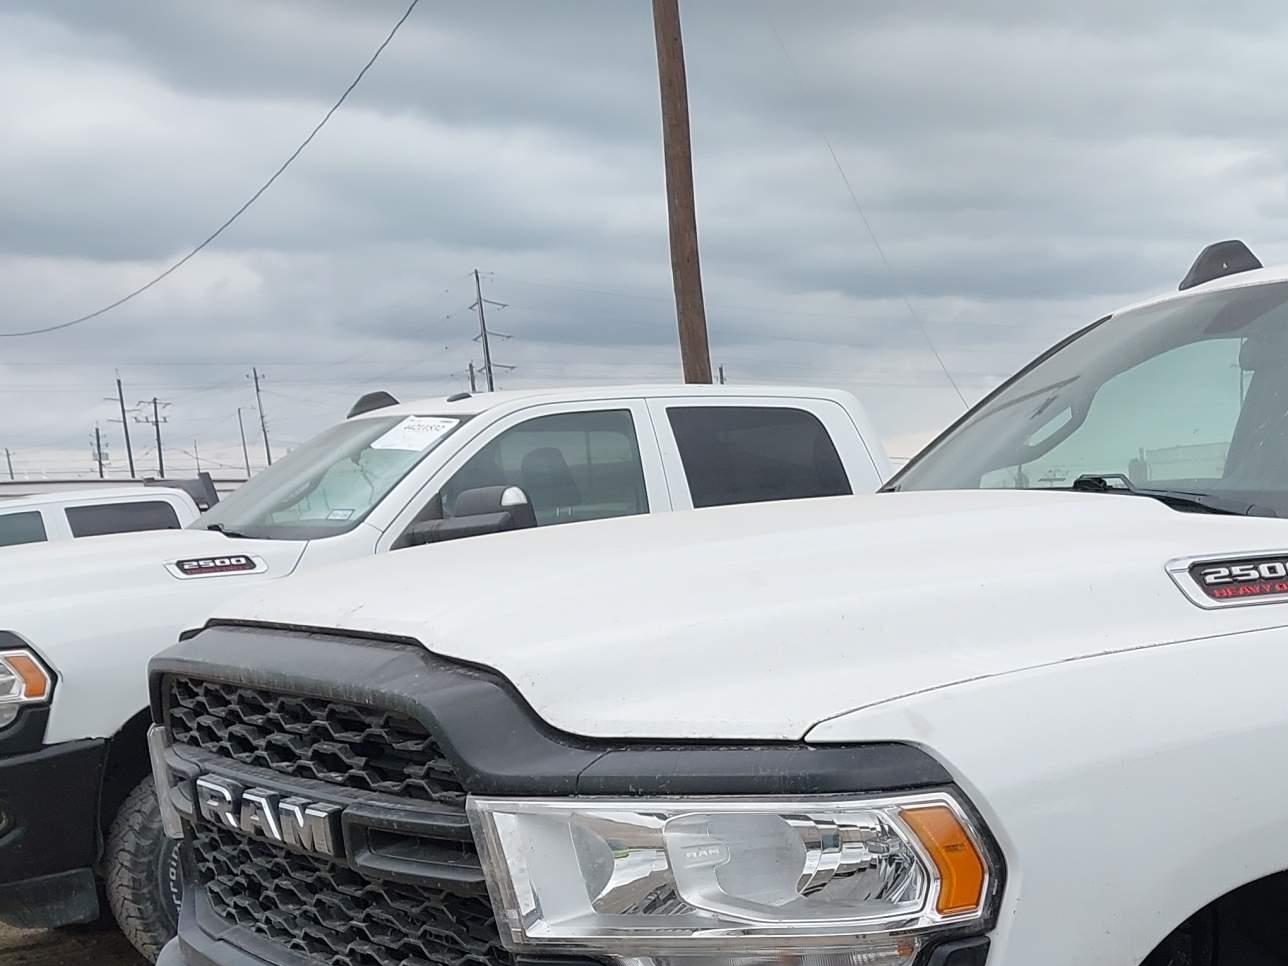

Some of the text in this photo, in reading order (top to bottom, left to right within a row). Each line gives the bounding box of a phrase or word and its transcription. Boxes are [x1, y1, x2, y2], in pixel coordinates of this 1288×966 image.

[182, 557, 247, 570] 2500
[1213, 583, 1274, 598] HEAVY
[196, 774, 342, 858] RAM
[685, 848, 720, 858] RAM
